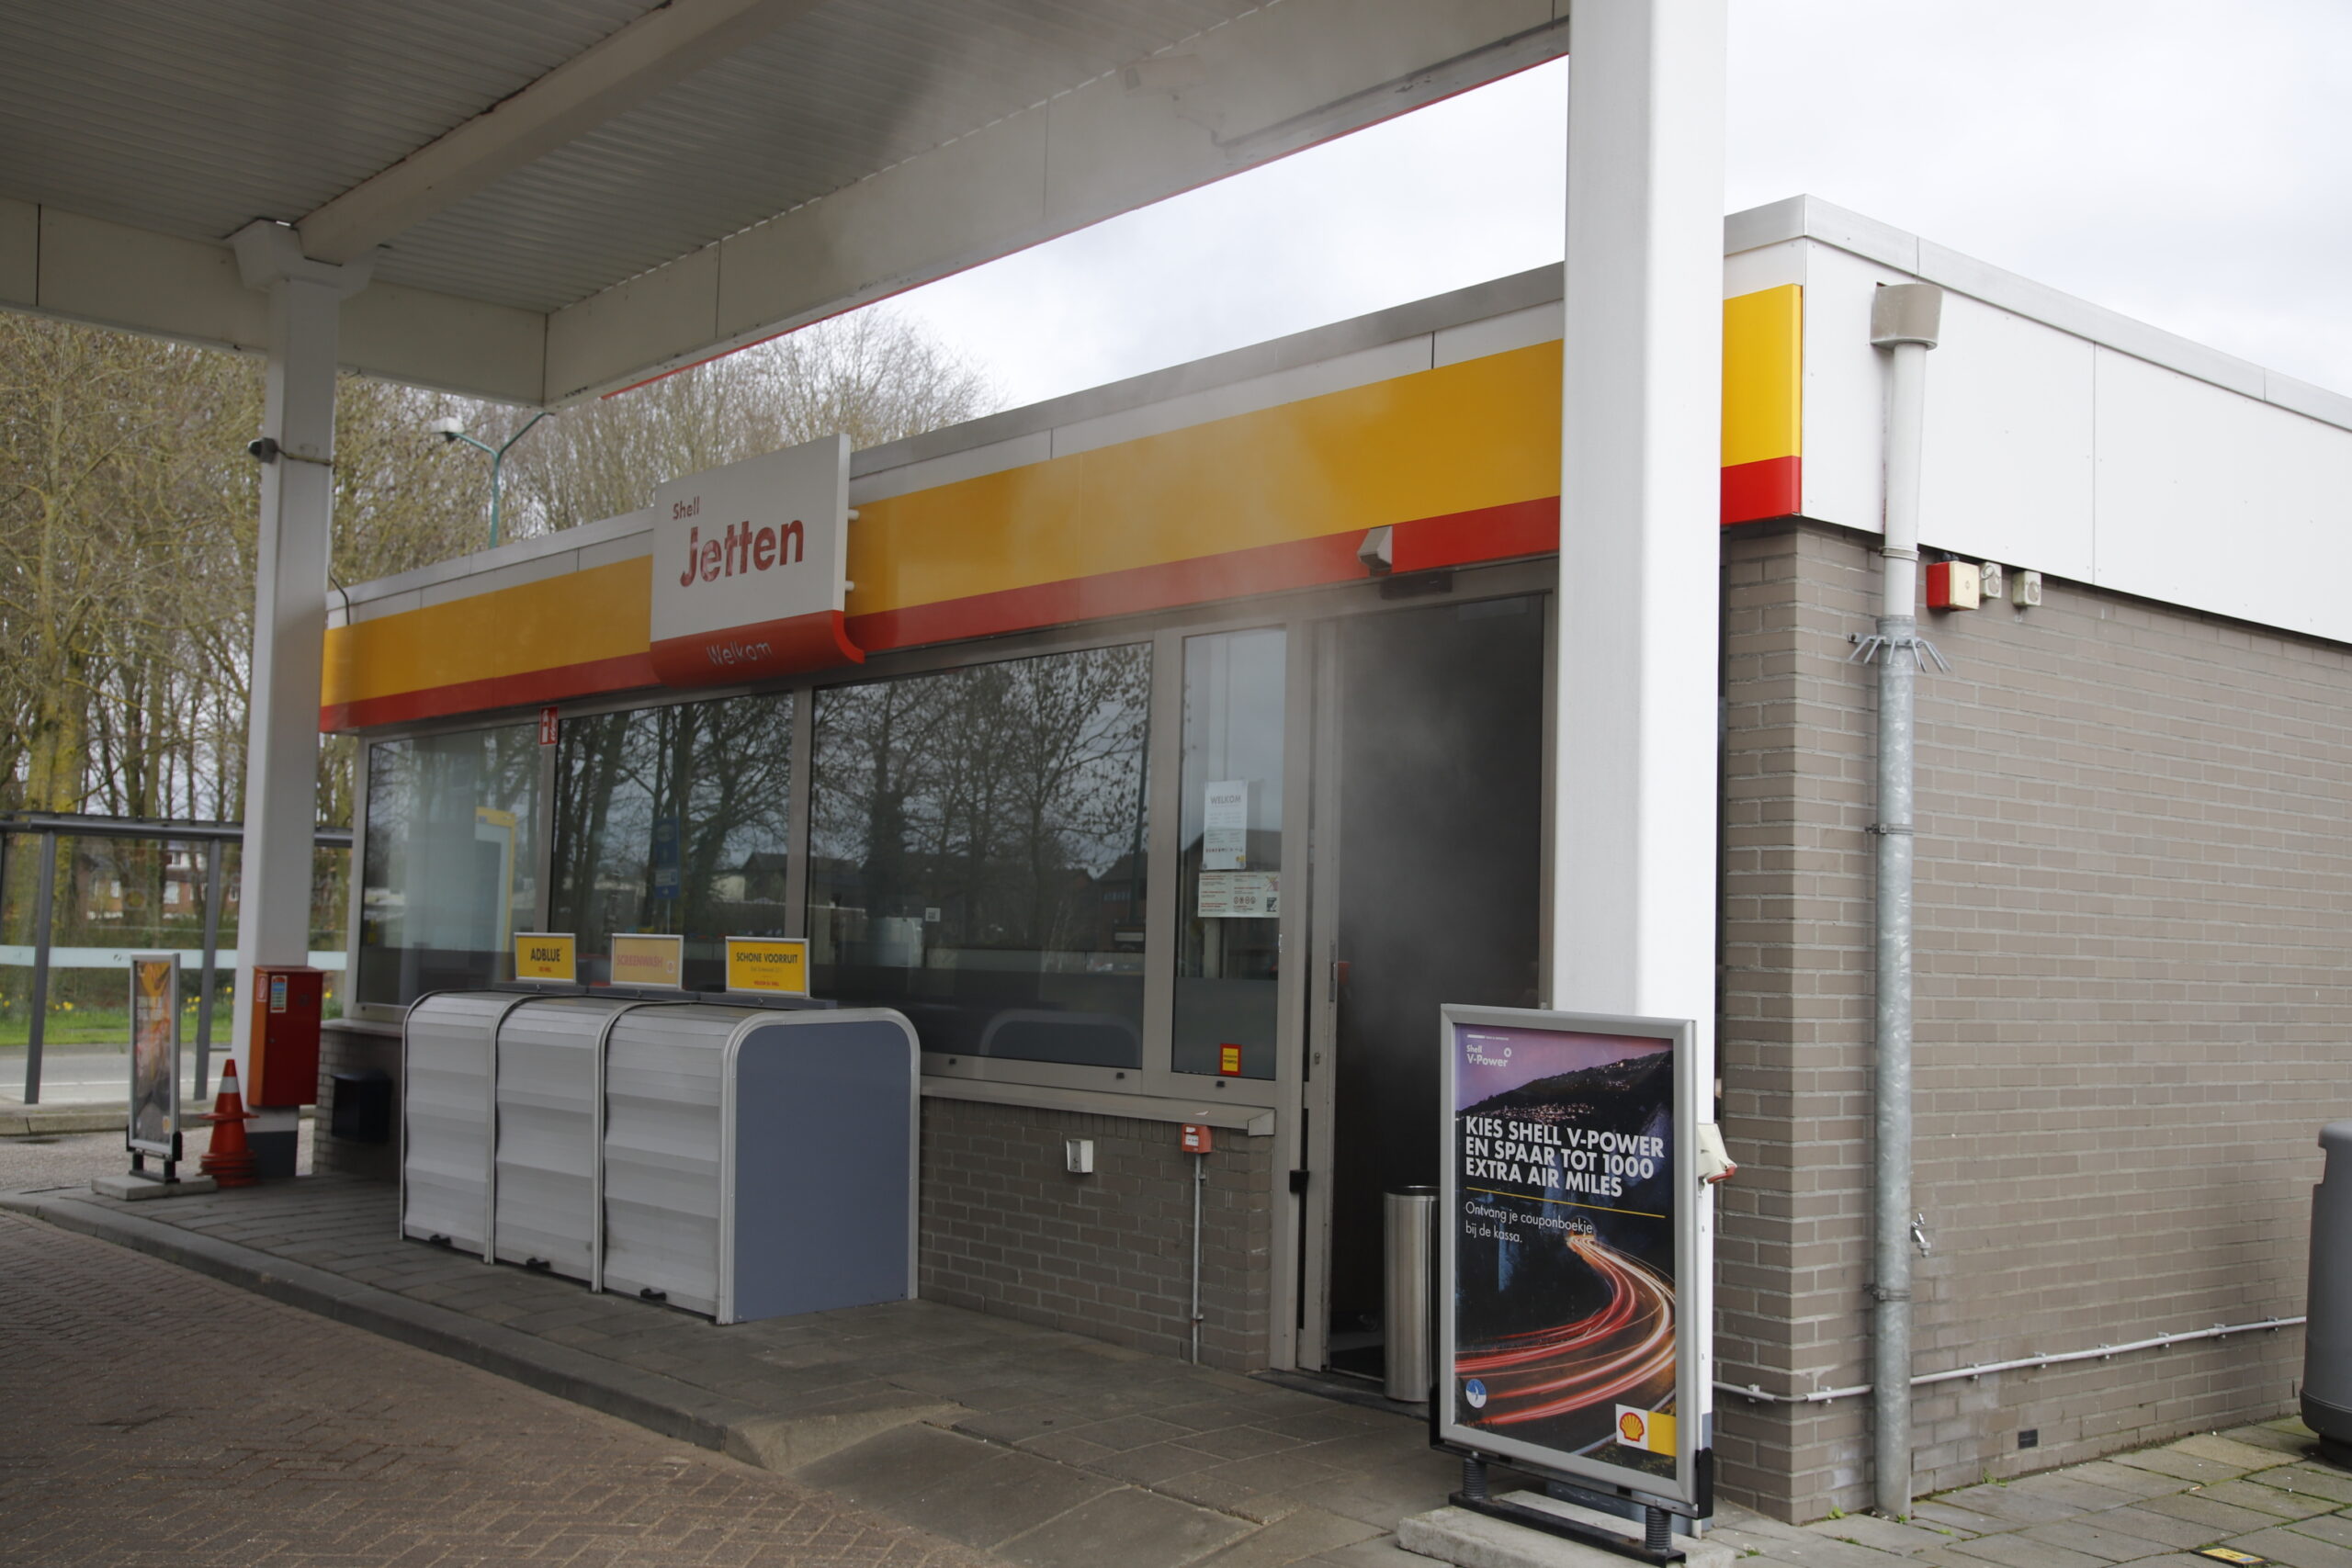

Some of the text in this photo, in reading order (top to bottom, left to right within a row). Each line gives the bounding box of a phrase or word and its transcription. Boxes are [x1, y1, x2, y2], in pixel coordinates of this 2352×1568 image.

[673, 496, 700, 521] Shell
[706, 639, 773, 666] Welkom
[1210, 795, 1242, 806] WELKOM
[530, 947, 561, 963] ADBLUE
[616, 954, 663, 969] SCREENWASH
[736, 952, 798, 964] SCHONE VOORRUIT
[1466, 1044, 1483, 1054] Shell
[1466, 1054, 1509, 1067] V-Power
[1465, 1116, 1665, 1158] KIES SHELL V-POWER
[1465, 1136, 1654, 1179] EN SPAAR TOT 1000
[1465, 1157, 1623, 1198] EXTRA AIR MILES
[1465, 1201, 1593, 1235] Ontvang je couponboekje
[1465, 1221, 1522, 1243] bij de kassa.
